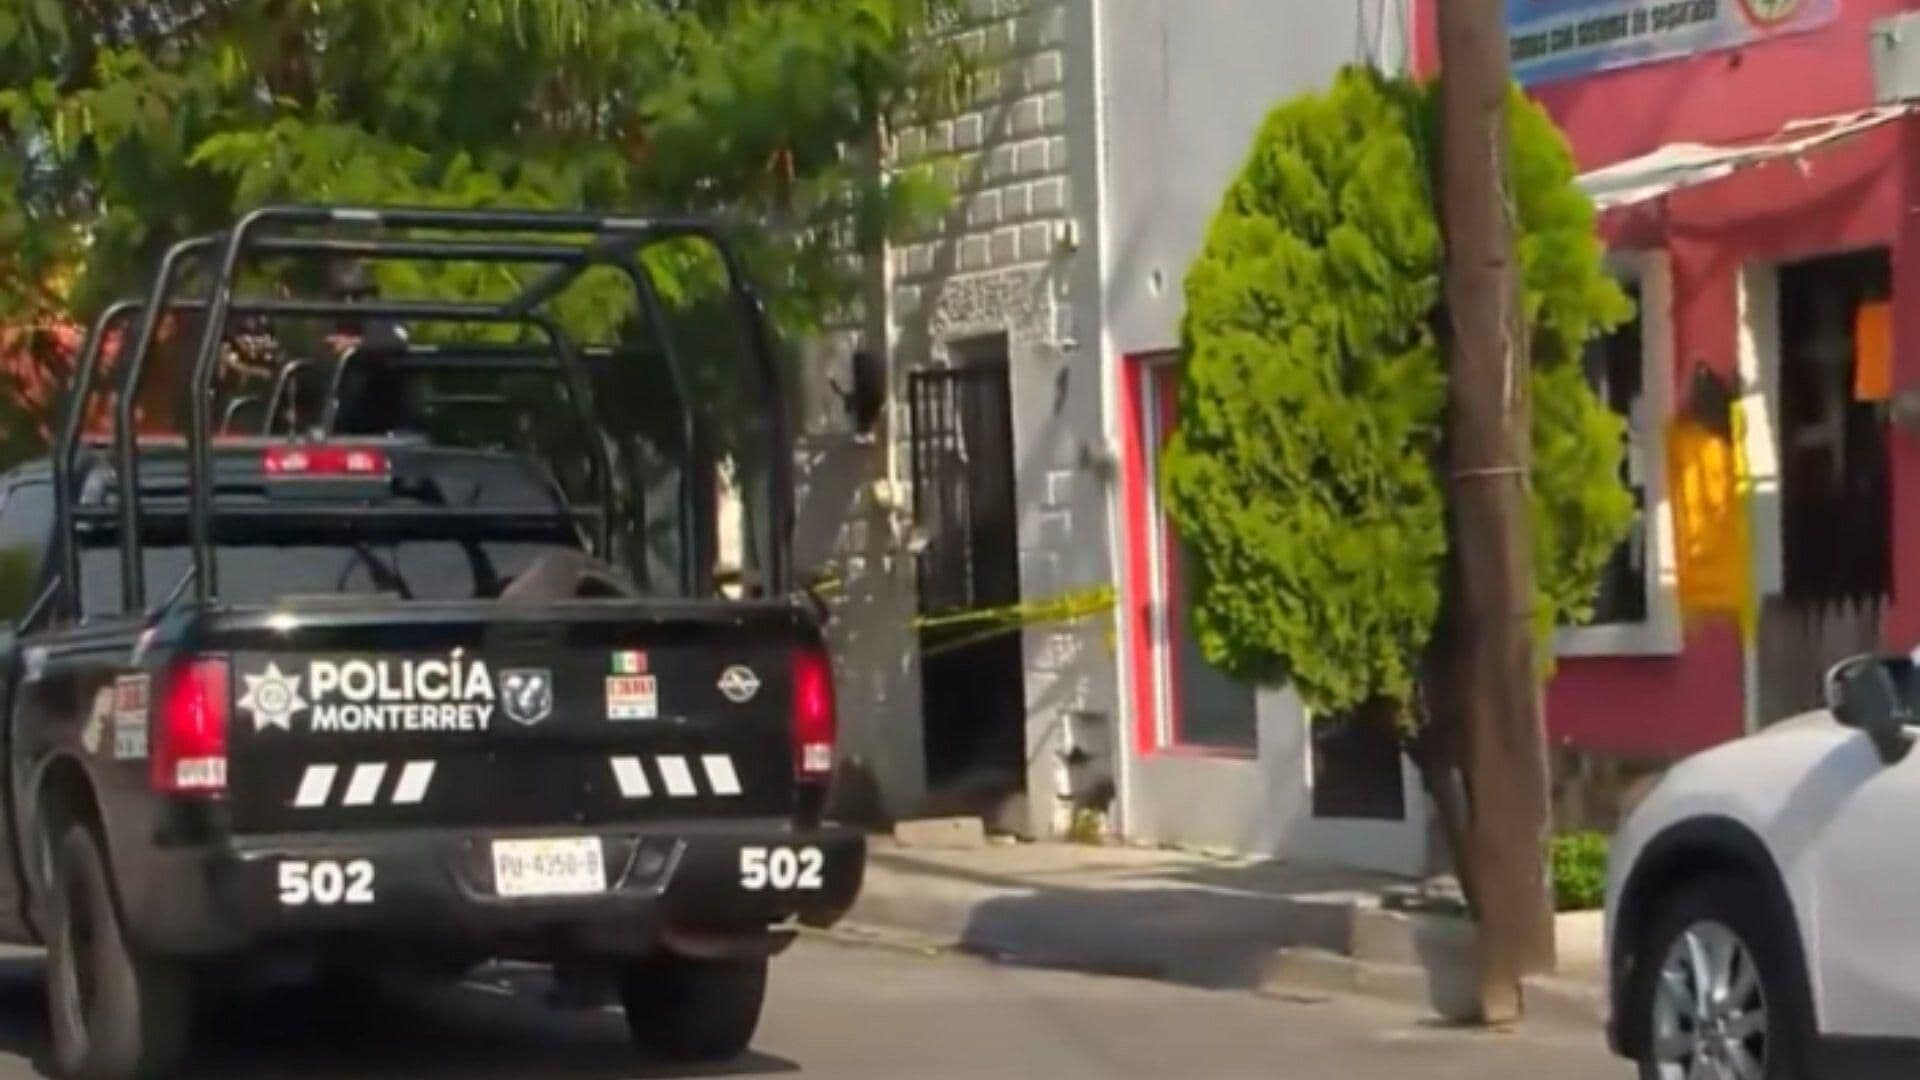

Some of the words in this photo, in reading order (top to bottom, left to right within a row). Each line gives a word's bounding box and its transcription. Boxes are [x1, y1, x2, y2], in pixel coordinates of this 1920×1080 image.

[309, 647, 494, 701] POLICÍA
[311, 703, 495, 731] MONTERREY
[277, 859, 375, 904] 502
[739, 846, 824, 889] 502
